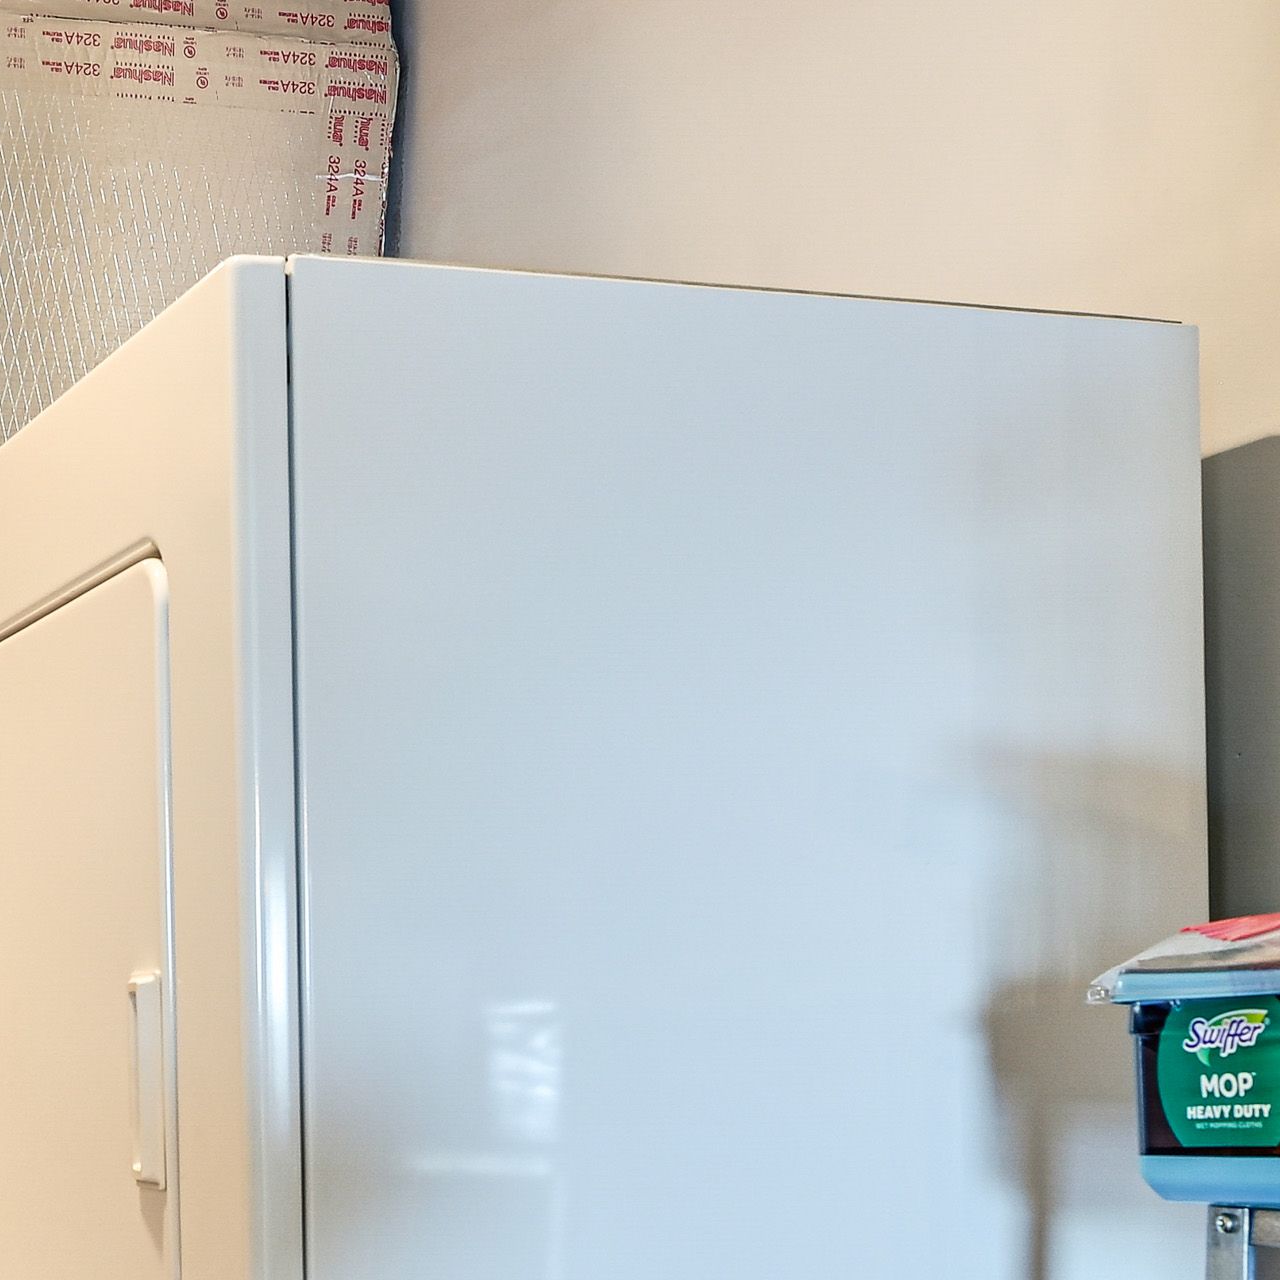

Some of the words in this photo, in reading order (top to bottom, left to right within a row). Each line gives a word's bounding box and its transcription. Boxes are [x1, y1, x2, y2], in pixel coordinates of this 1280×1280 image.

[300, 13, 334, 26] 324A
[65, 31, 101, 46] 324A
[110, 36, 175, 56] Nashua
[281, 50, 316, 66] 324A
[324, 56, 388, 76] Nashua
[64, 61, 100, 76] 324A
[110, 67, 175, 87] Nashua
[280, 79, 316, 95] 324A
[324, 84, 387, 105] Nashua
[326, 155, 340, 193] 324A
[352, 160, 366, 197] 324A
[1184, 1018, 1264, 1056] Swiffer
[1200, 1071, 1254, 1098] MOP
[1186, 1104, 1231, 1119] HEAVY
[1233, 1103, 1271, 1118] DUTY
